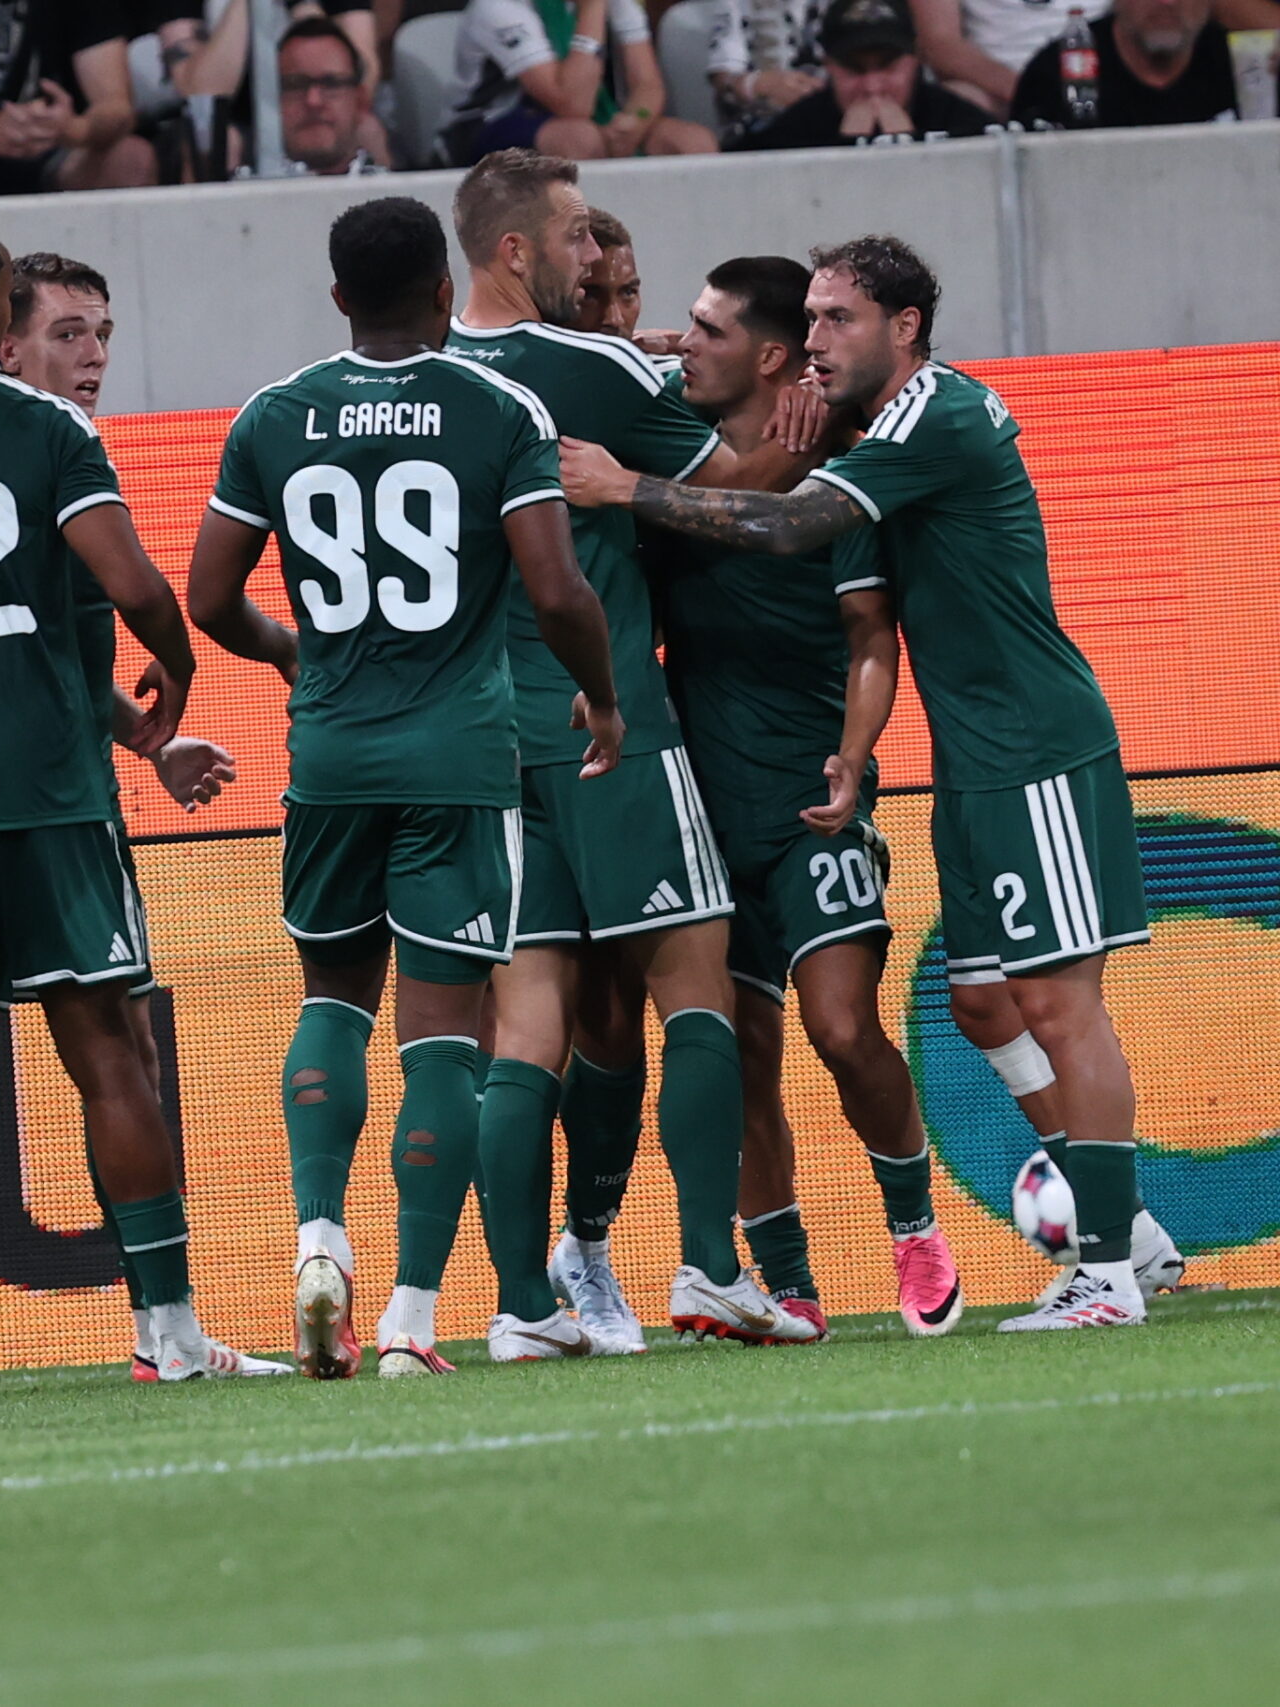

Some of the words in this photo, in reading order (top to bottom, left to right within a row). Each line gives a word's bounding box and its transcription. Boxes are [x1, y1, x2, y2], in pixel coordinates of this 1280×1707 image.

[338, 401, 441, 438] GARCIA
[282, 459, 460, 634] 99
[808, 848, 877, 915] 20
[992, 872, 1036, 940] 2
